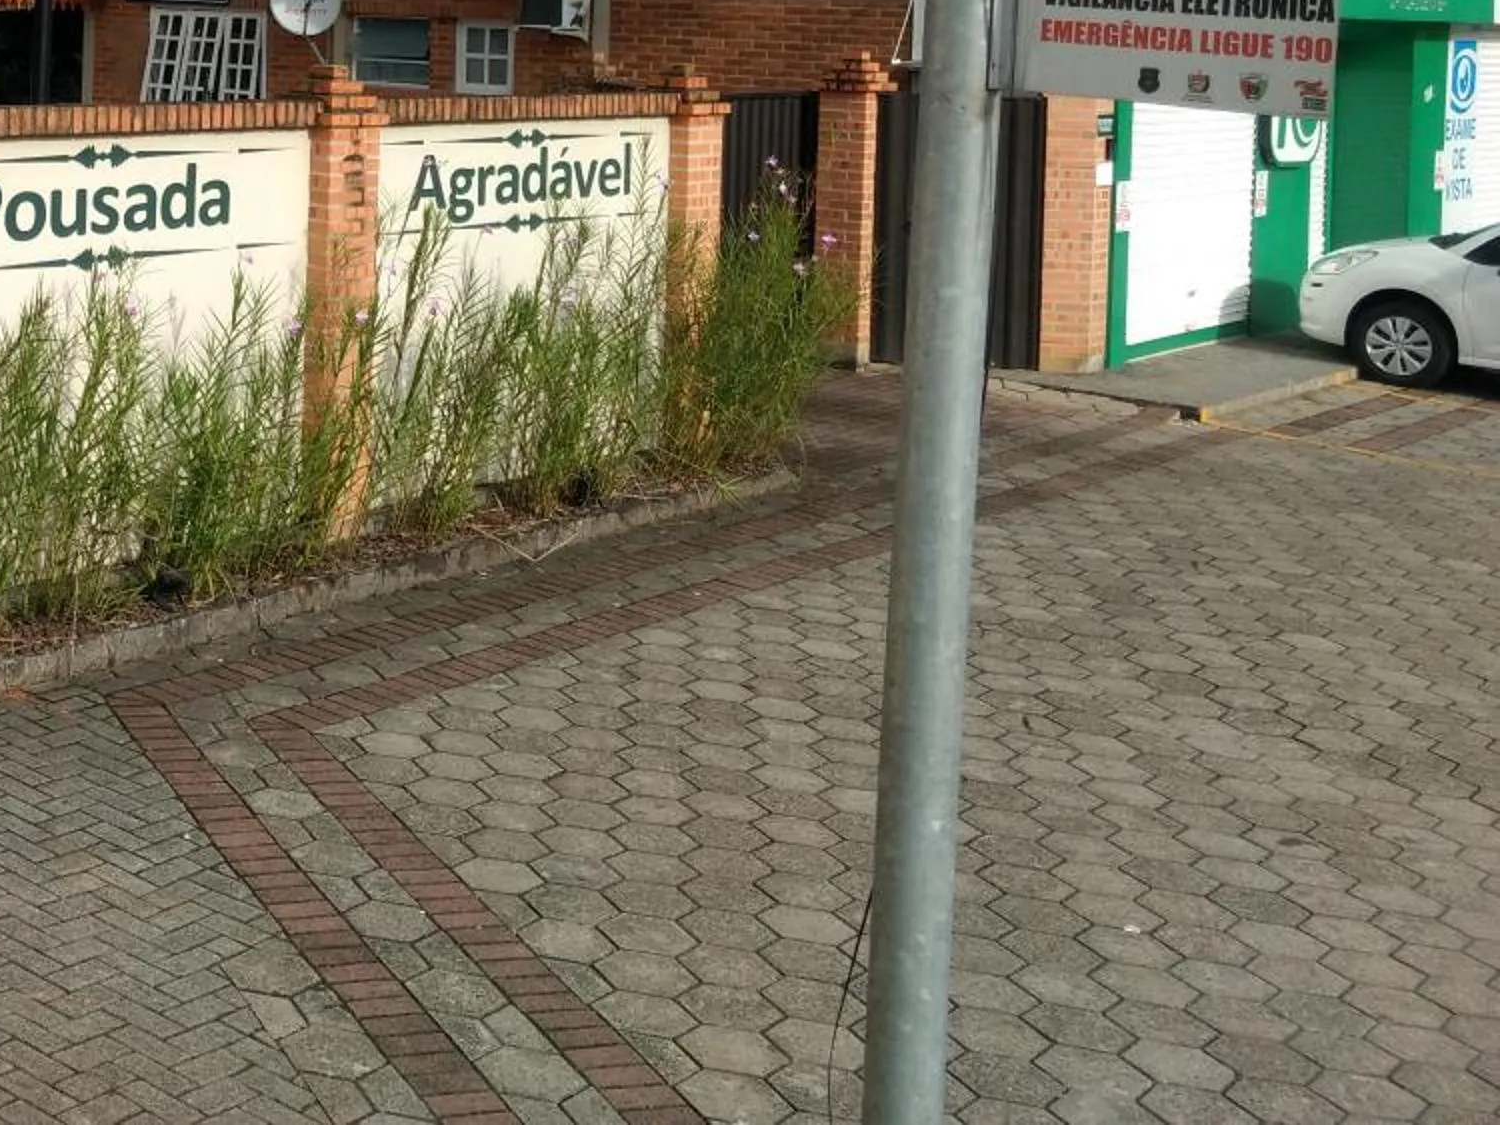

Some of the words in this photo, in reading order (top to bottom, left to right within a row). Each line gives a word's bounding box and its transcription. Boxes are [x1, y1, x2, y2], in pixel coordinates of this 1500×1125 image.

[1040, 19, 1193, 53] EMERGÊNCIA
[1200, 28, 1274, 59] LIGUE
[1281, 35, 1333, 64] 190
[1446, 118, 1477, 140] EXAME
[1453, 147, 1467, 170] DE
[409, 143, 633, 225] Agradável
[1445, 178, 1473, 201] VISTA
